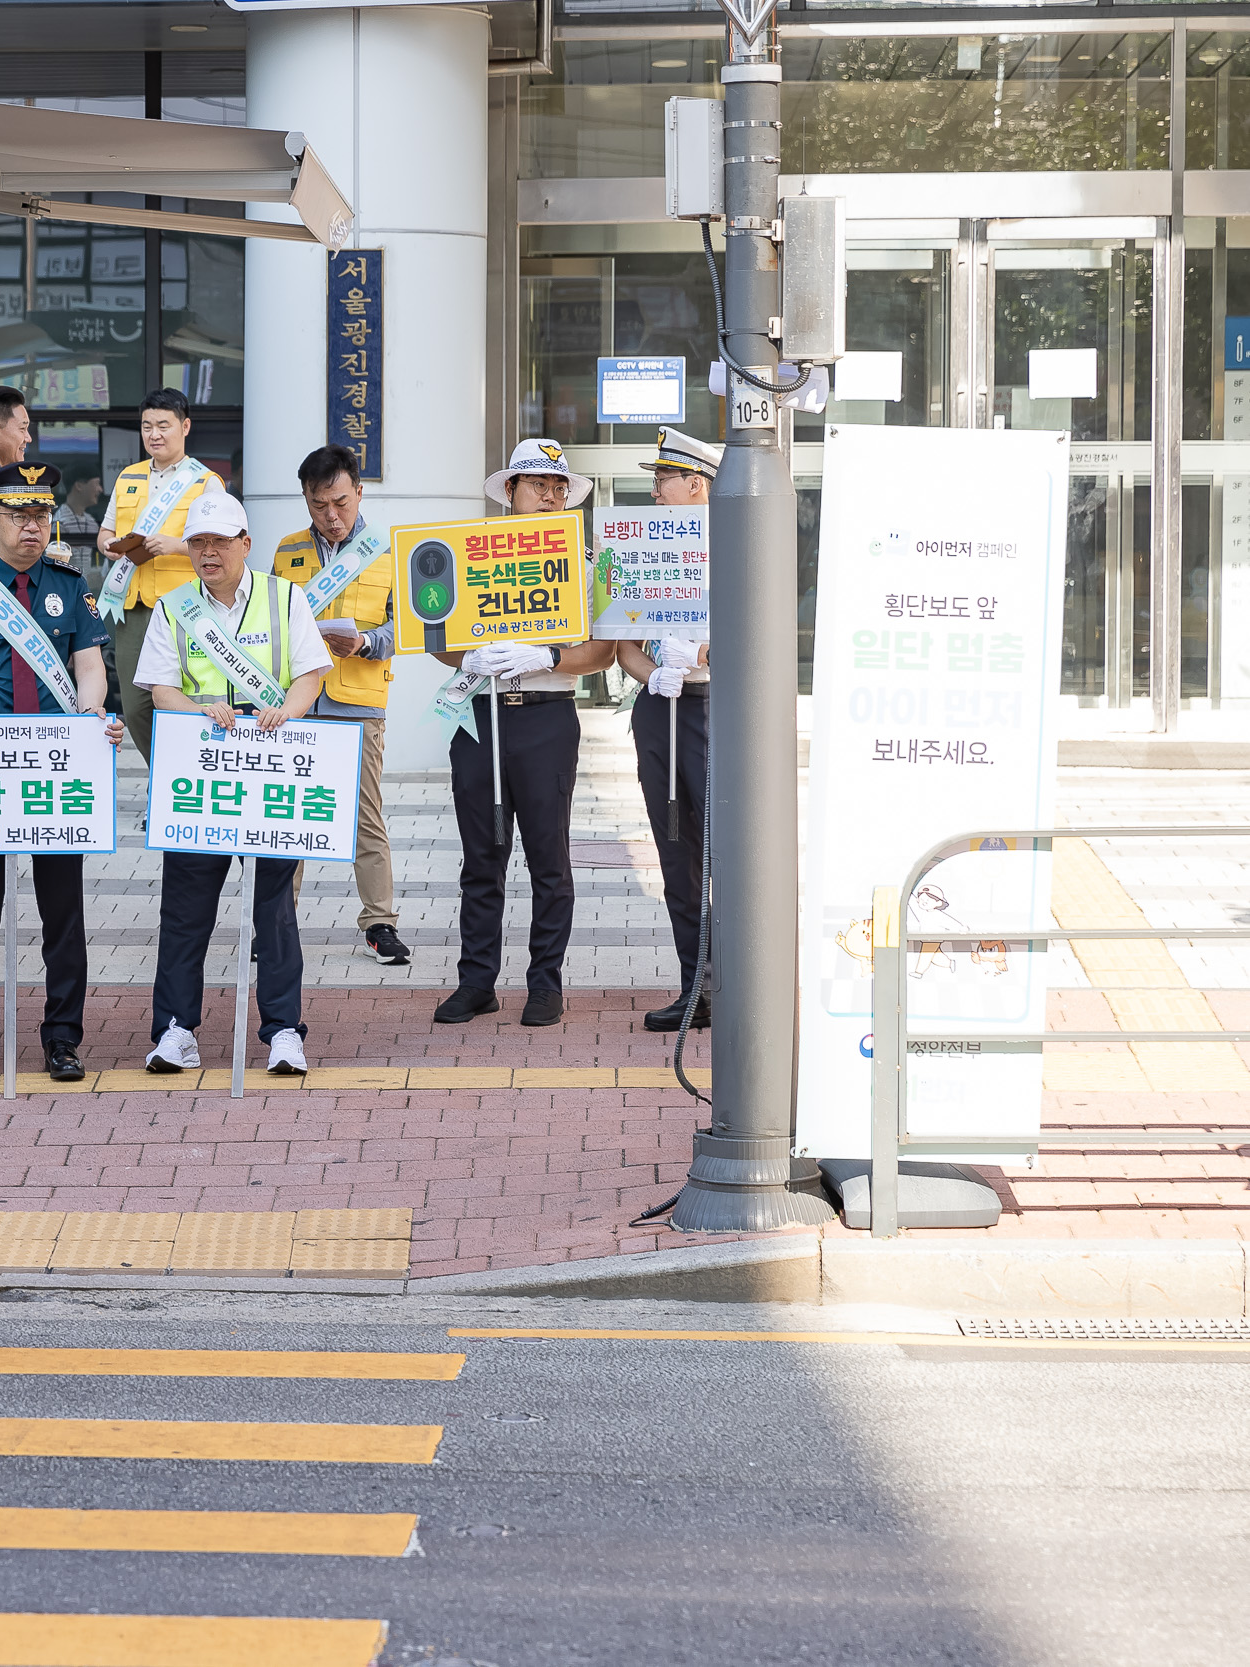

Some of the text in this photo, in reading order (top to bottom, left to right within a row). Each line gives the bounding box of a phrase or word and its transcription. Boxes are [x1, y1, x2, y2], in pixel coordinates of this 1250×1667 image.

[616, 361, 637, 370] CCTV
[737, 400, 769, 424] 10-8
[160, 480, 184, 506] 아이
[603, 520, 701, 540] 보행자 안전수칙
[465, 529, 567, 561] 횡단보도
[612, 552, 619, 565] 1.
[621, 551, 639, 564] 길을
[641, 551, 659, 564] 건널
[662, 551, 679, 564] 때는
[916, 540, 1017, 559] 아이먼저 캠페인
[306, 564, 349, 609] 아이 먼
[466, 558, 569, 589] 녹색등에
[612, 568, 702, 582] 2. 녹색 보행 신호 확인
[477, 588, 560, 618] 건너요!
[612, 587, 701, 600] 3. 차량 정지 후 건너기
[646, 610, 708, 622] 서울광진경찰서
[884, 594, 998, 620] 횡단보도 앞
[487, 618, 568, 634] 서울광진경찰서
[24, 635, 56, 673] 먼저
[204, 629, 249, 678] 횡단보도
[247, 674, 262, 690] 앞
[852, 629, 1026, 673] 일단 멈춤
[849, 686, 1024, 728] 아이 먼저
[35, 726, 70, 740] 캠페인
[230, 727, 316, 745] 아이먼저 캠페인
[49, 749, 71, 772] 앞
[198, 748, 315, 777] 횡단보도 앞
[872, 739, 994, 765] 보내주세요.
[22, 779, 95, 815] 멈춤
[171, 777, 337, 822] 일단 멈춤
[5, 827, 97, 845] 보내주세요.
[165, 824, 336, 851] 아이 먼저 보내주세요.
